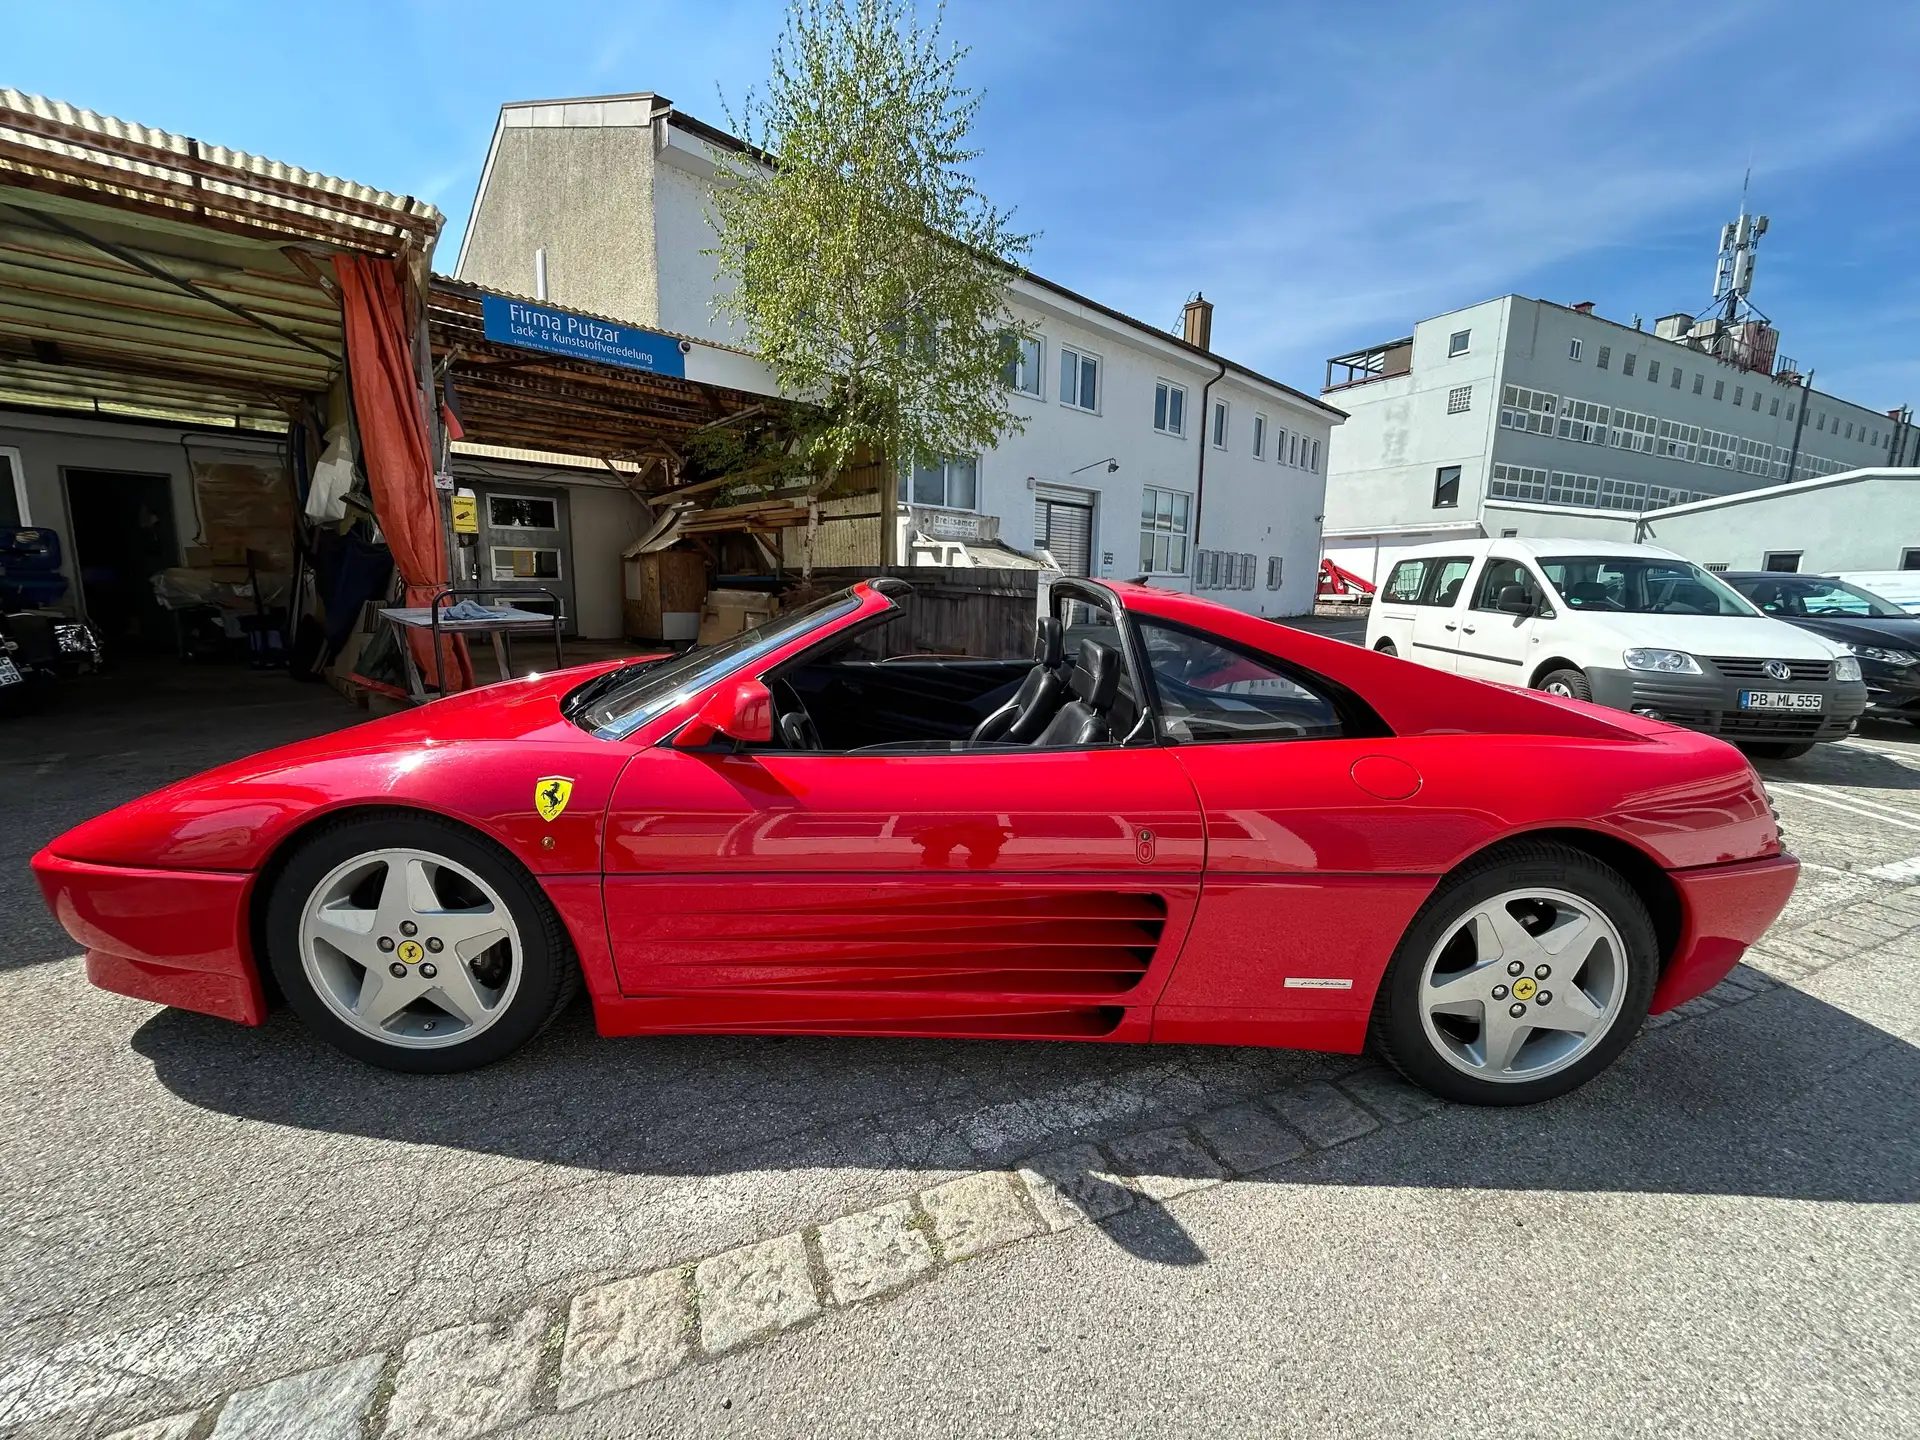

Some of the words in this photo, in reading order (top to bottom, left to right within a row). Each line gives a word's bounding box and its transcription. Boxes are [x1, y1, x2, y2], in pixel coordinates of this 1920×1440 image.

[509, 303, 561, 331] Firma
[568, 317, 620, 344] Putzar
[511, 322, 538, 338] Lack-
[541, 329, 549, 341] &
[552, 332, 653, 364] Kunststoffveredelung
[935, 515, 976, 527] Breitsamer
[1750, 693, 1768, 706] PB
[1777, 694, 1794, 707] ML
[1796, 695, 1821, 708] 555
